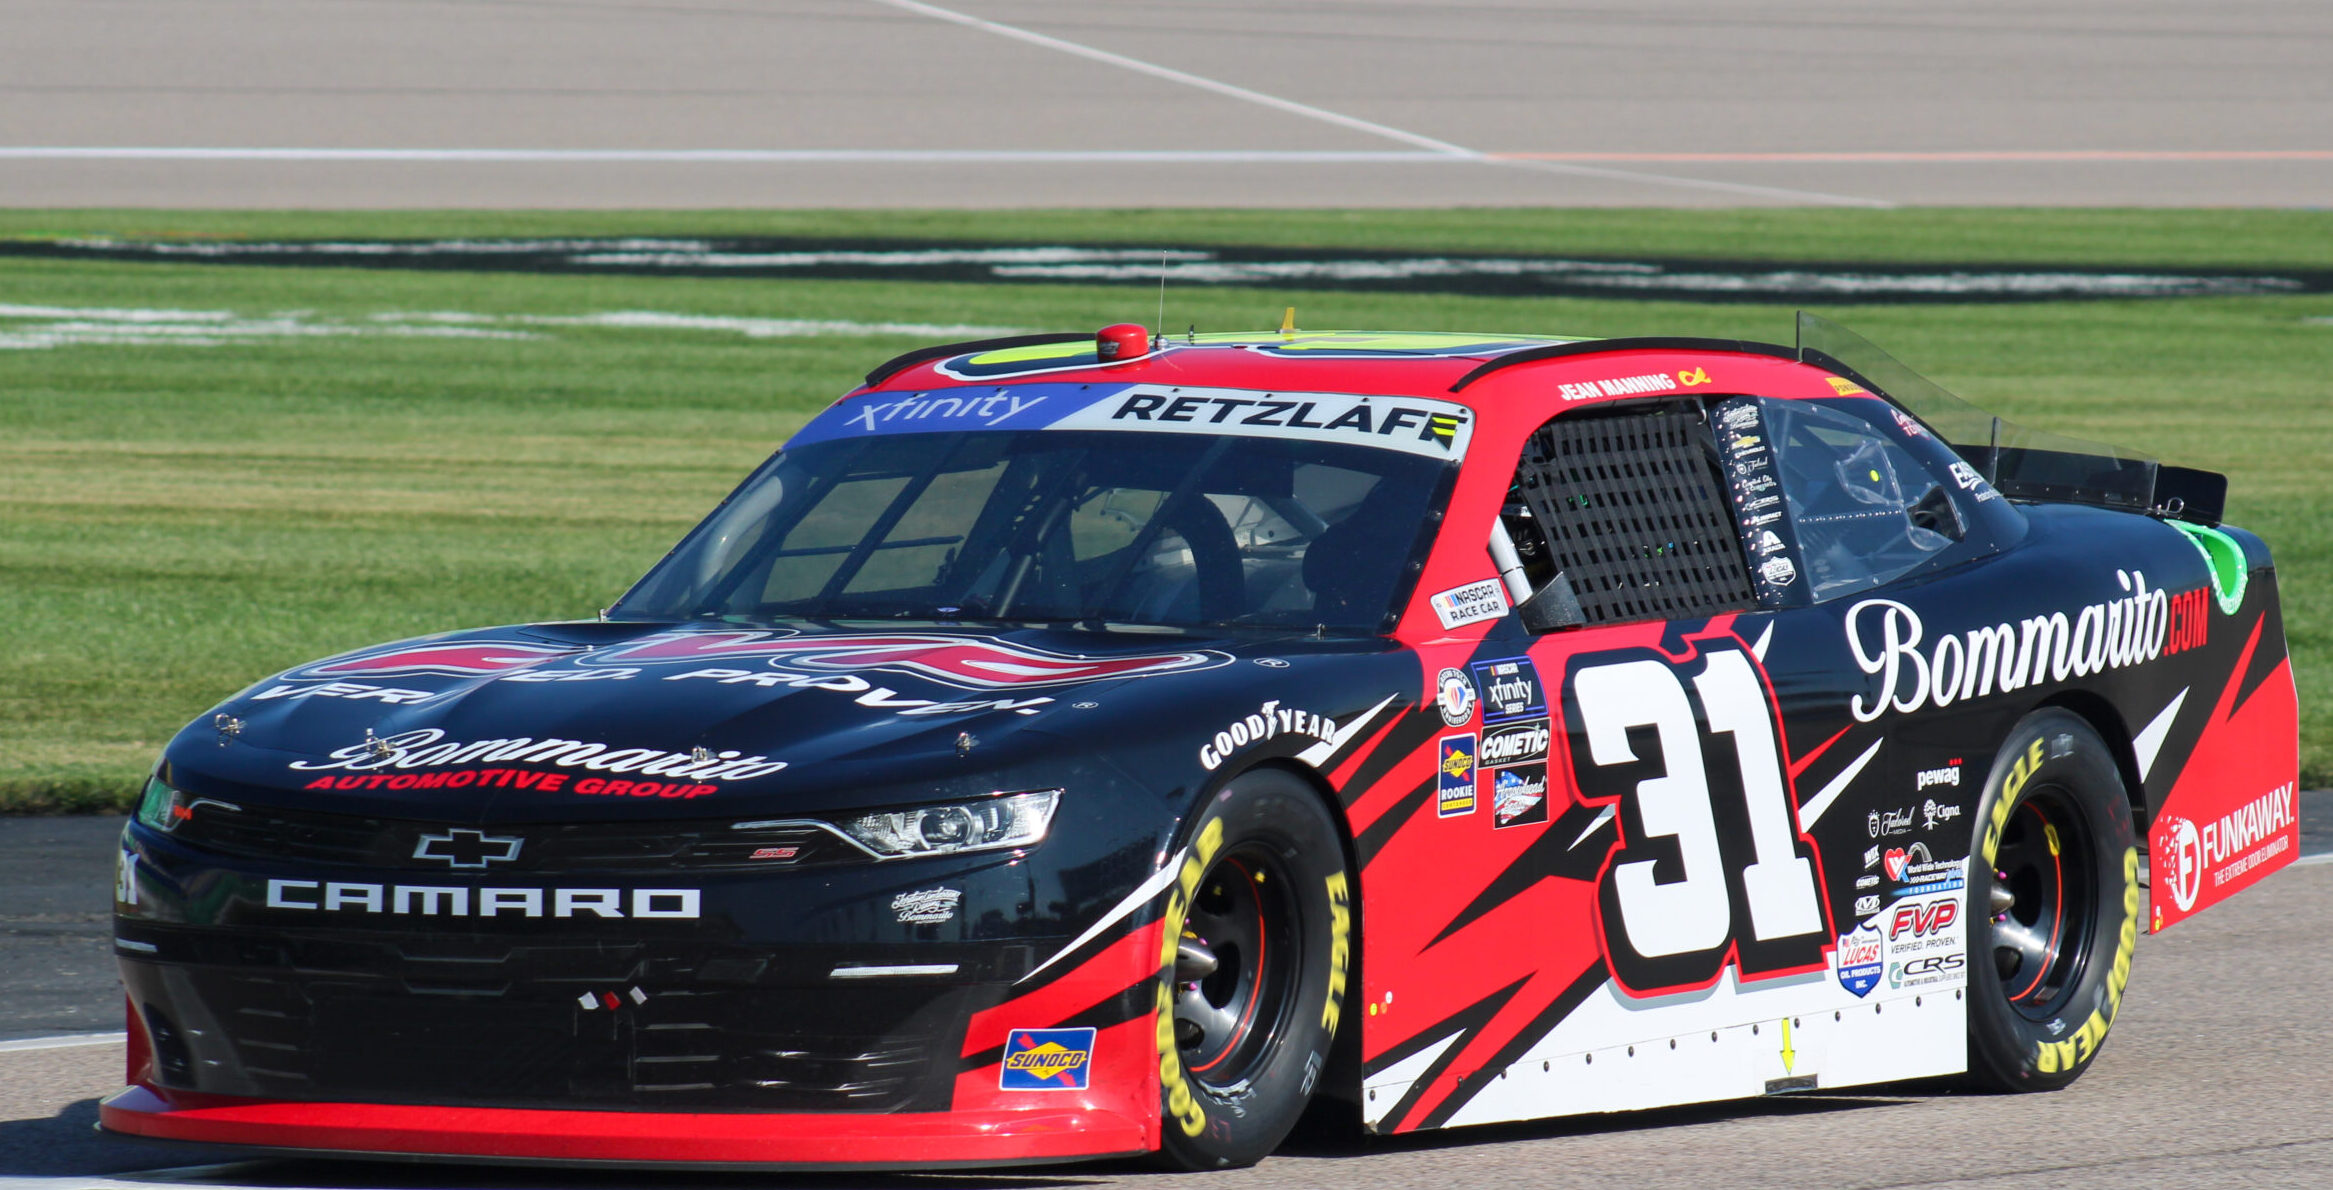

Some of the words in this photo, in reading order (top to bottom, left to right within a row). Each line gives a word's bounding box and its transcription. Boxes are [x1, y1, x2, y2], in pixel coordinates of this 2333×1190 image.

[1557, 381, 1604, 401] JEAN
[1597, 373, 1677, 396] MANNING
[843, 386, 1048, 431] xfinity
[1454, 584, 1495, 606] NASCAR
[1450, 605, 1479, 622] RACE
[1480, 601, 1500, 614] CAR
[1489, 676, 1532, 709] xfinity
[1505, 702, 1524, 714] SERIES
[1200, 700, 1336, 771] GOODYEAR
[1481, 728, 1549, 760] COMETIC
[289, 728, 789, 780] Bommarito
[1442, 756, 1474, 772] SUNOCO
[1485, 756, 1512, 766] GASKET
[304, 768, 570, 792] AUTOMOTIVE
[573, 778, 719, 799] GROUP
[1917, 766, 1960, 791] pewag
[1441, 785, 1474, 801] ROOKIE
[1573, 648, 1823, 958] 31
[1982, 736, 2046, 867] EAGLE
[2213, 868, 2225, 887] THE
[2225, 857, 2248, 882] EXTREME
[2248, 849, 2261, 870] ODOR
[2261, 834, 2289, 863] ELIMINATOR
[266, 879, 701, 919] CAMARO
[1889, 898, 1960, 942] FVP
[1321, 870, 1351, 1041] EAGLE
[1843, 944, 1880, 966] LUCAS
[1903, 953, 1965, 975] CRS
[1840, 970, 1851, 979] OIL
[1851, 966, 1881, 978] PRODUCTS
[1855, 979, 1869, 989] INC.
[1010, 1052, 1084, 1068] SUNOCO
